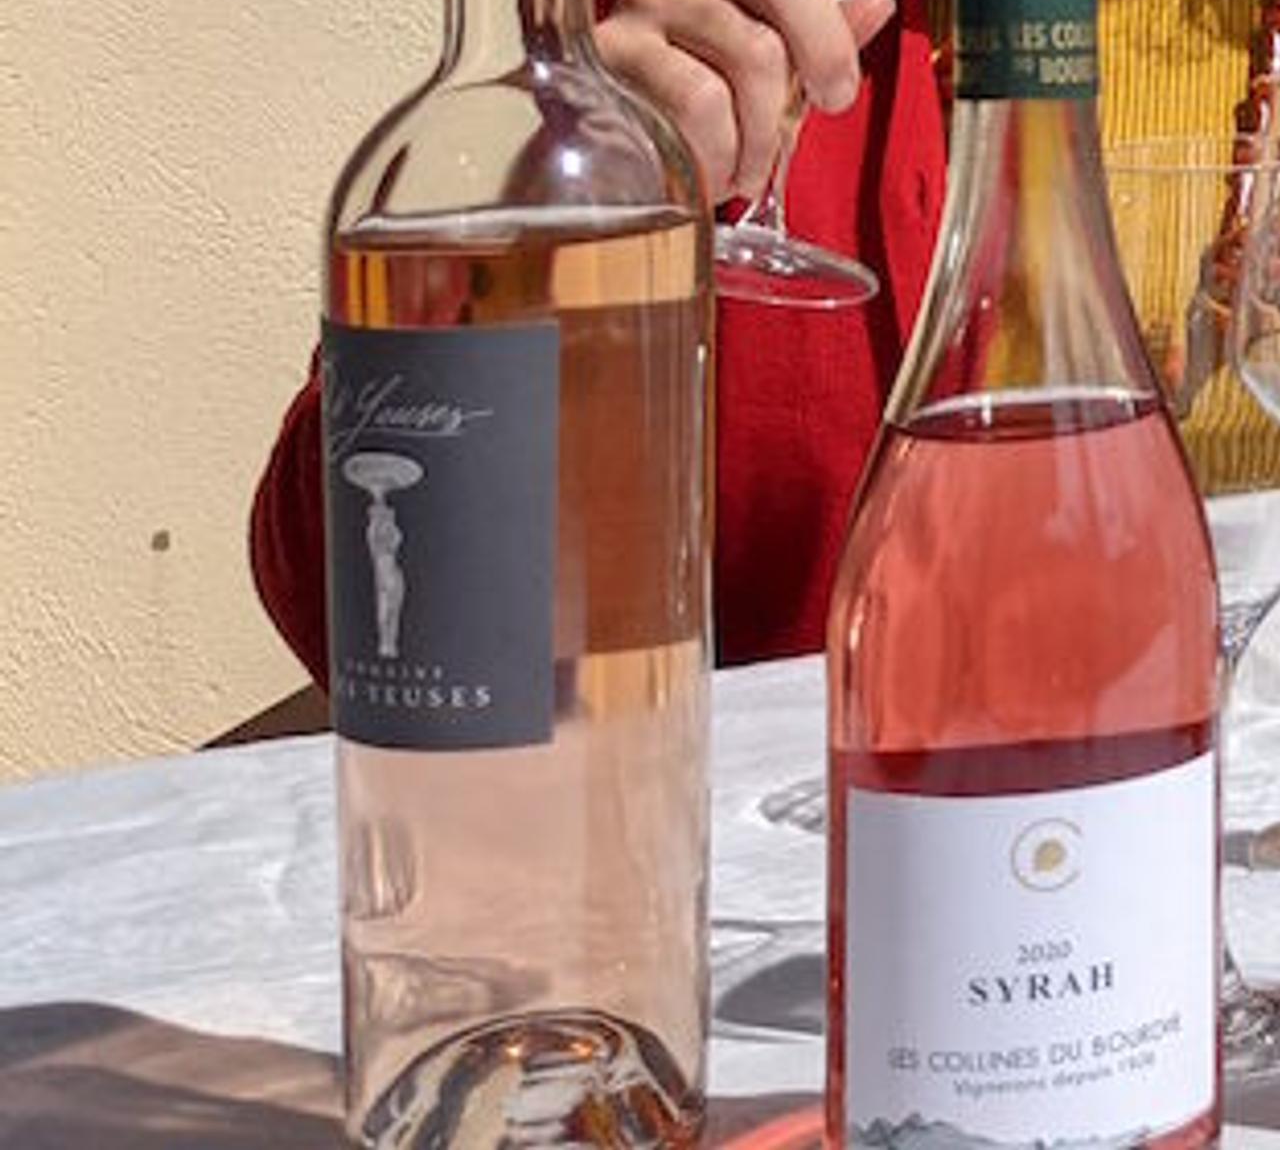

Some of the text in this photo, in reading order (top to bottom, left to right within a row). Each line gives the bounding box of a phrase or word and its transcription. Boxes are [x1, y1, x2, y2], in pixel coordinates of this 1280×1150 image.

[1016, 939, 1074, 966] 2020
[967, 960, 1115, 1007] SYRAH
[927, 1046, 1040, 1073] COLLINES
[1049, 1039, 1082, 1066] DU
